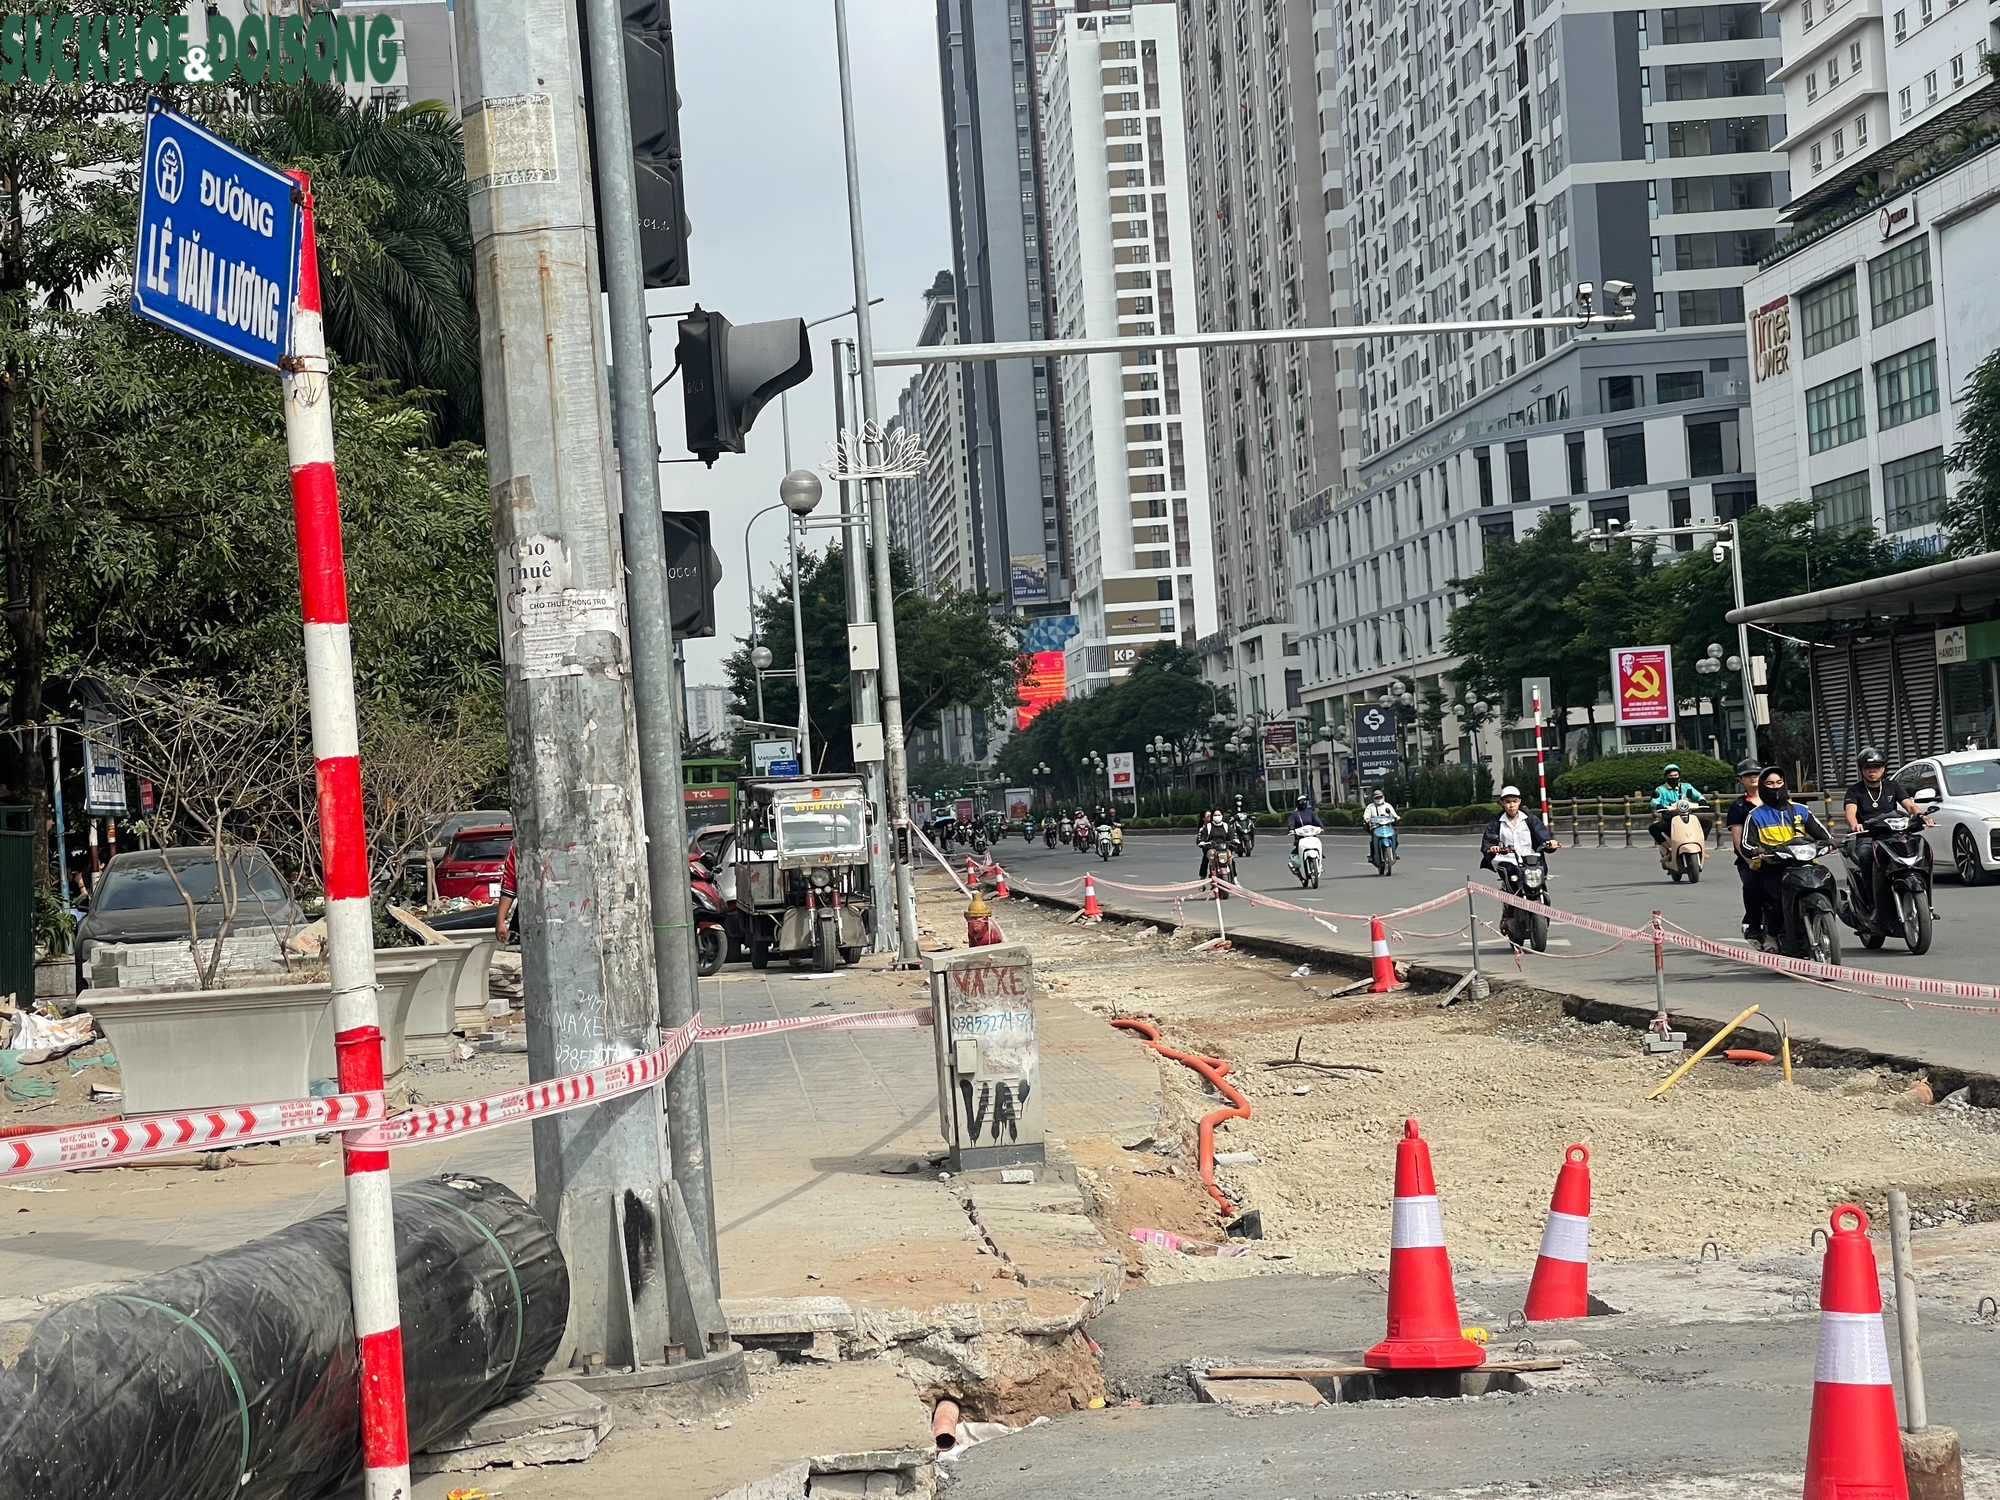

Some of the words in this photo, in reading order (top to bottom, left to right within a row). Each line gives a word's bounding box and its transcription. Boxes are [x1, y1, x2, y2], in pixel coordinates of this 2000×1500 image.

[200, 169, 274, 238] ĐƯỜNG
[146, 216, 173, 296] LÊ
[177, 229, 215, 315] VĂN
[216, 258, 280, 345] LƯƠNG
[1749, 305, 1791, 366] Times
[508, 560, 552, 584] Thuê
[529, 602, 545, 610] CHO
[547, 598, 566, 609] THUÊ
[1938, 647, 1954, 659] HANOI
[1954, 645, 1964, 657] BRT
[692, 790, 713, 798] TCL
[992, 966, 1026, 996] XE
[582, 1015, 604, 1038] XE
